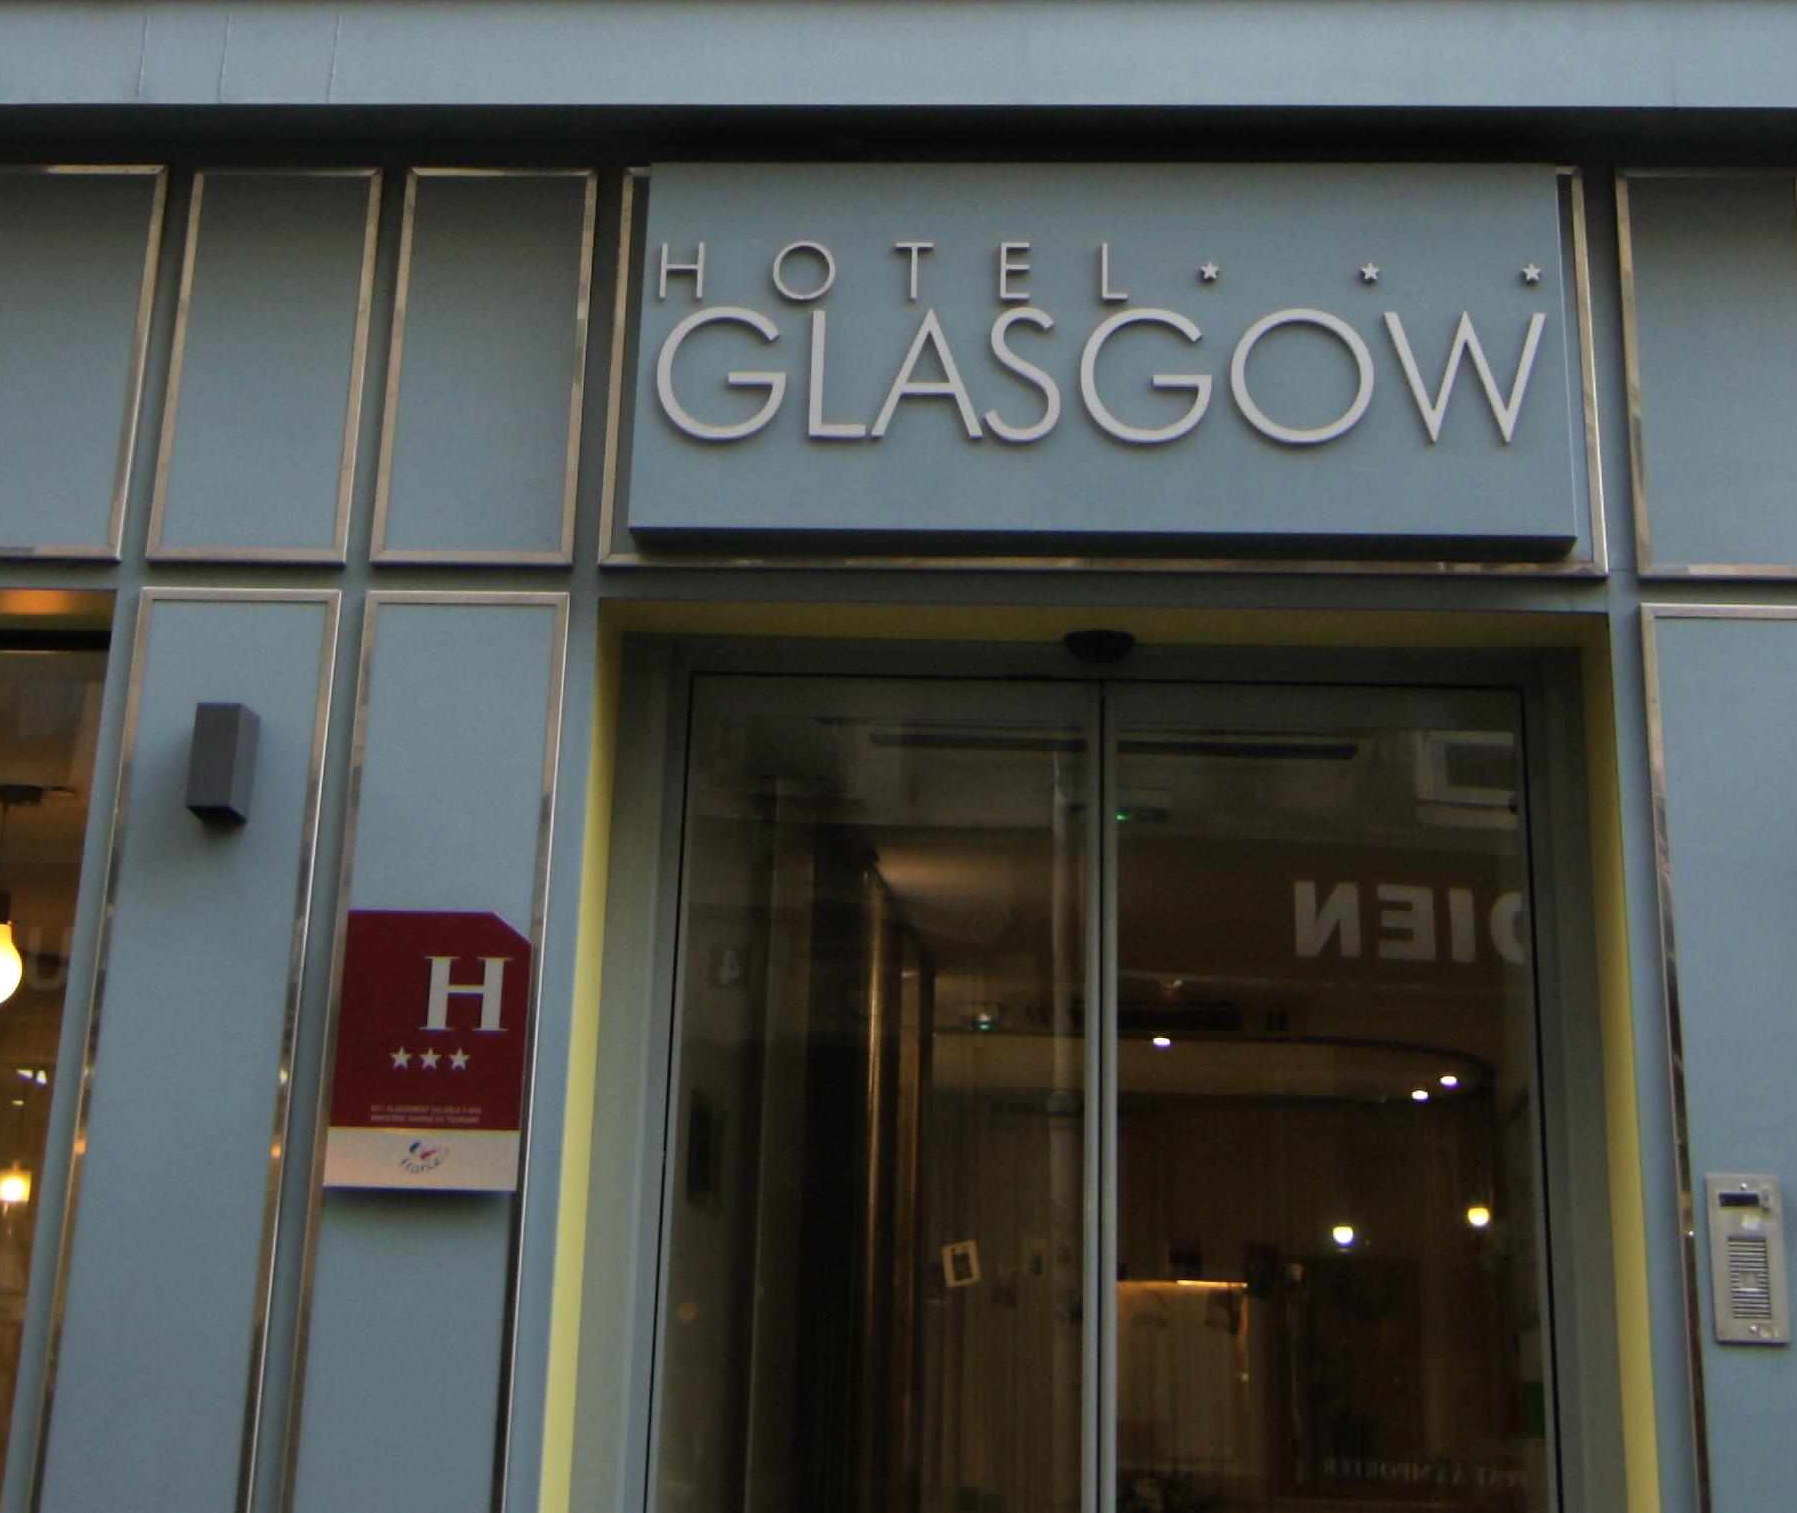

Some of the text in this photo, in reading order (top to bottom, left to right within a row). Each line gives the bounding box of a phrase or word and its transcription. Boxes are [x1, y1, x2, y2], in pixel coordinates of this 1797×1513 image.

[658, 240, 1128, 301] HOTEL
[655, 307, 1547, 444] GLASGOW
[418, 956, 513, 1032] H
